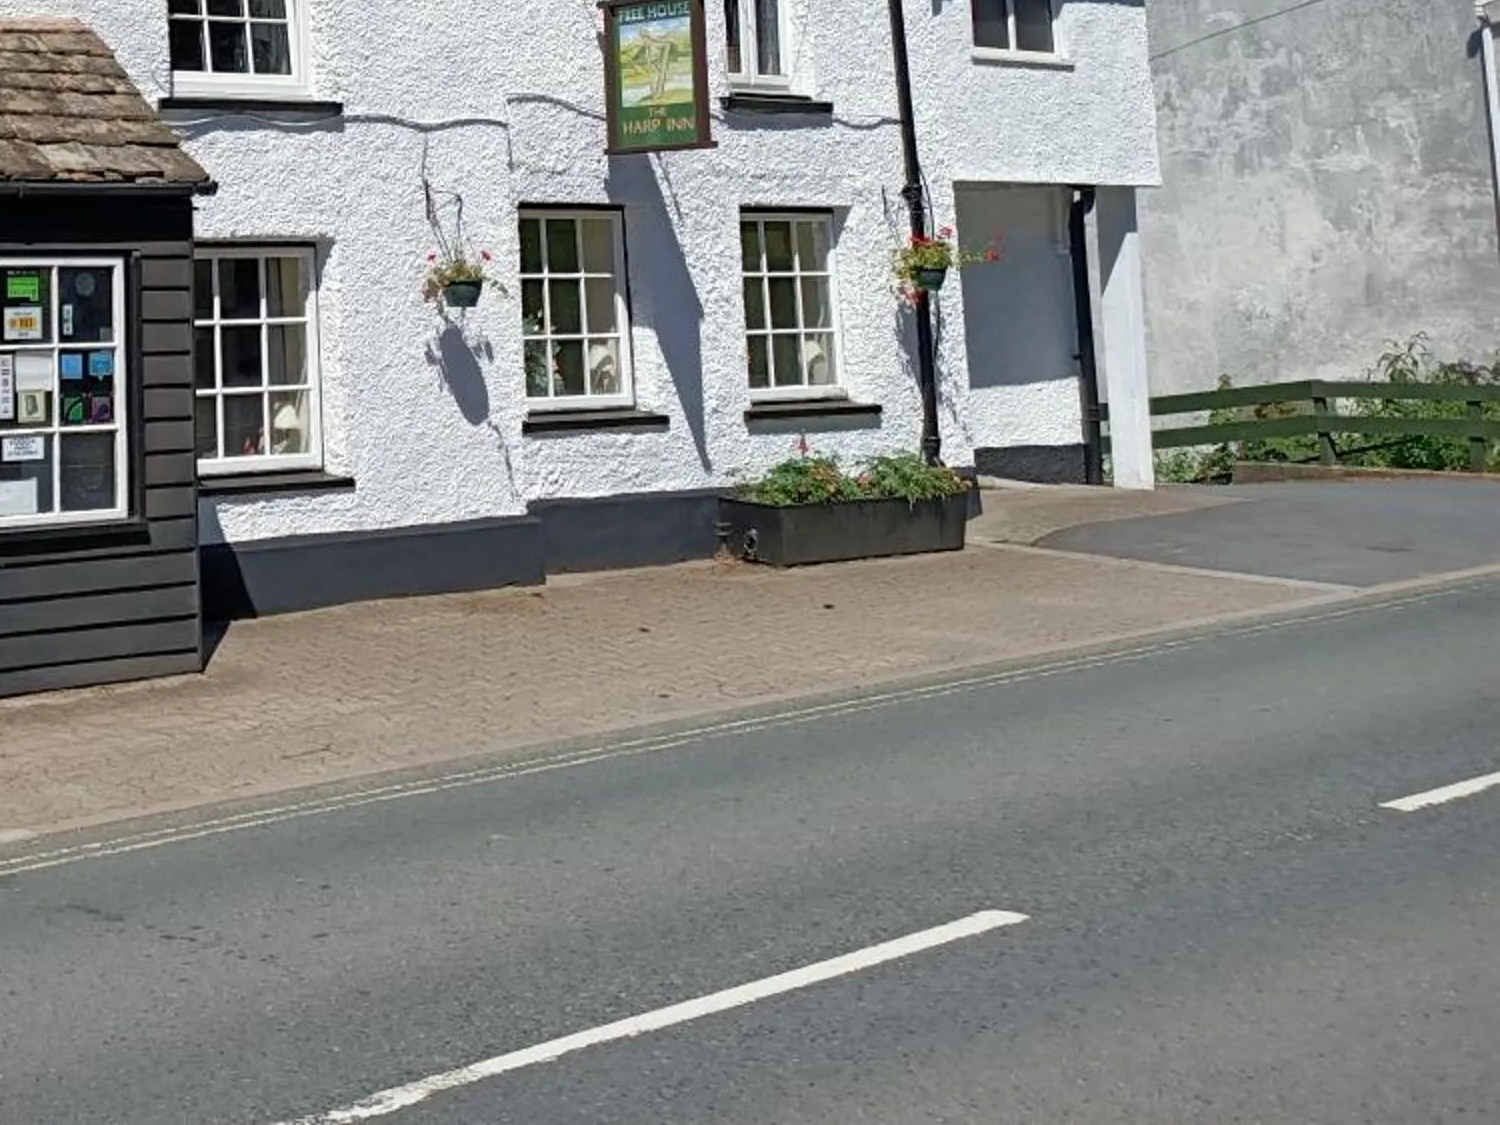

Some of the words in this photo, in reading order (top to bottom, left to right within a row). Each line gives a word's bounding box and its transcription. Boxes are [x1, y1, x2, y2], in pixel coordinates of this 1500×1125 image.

[619, 6, 645, 24] FREE
[647, 1, 691, 19] HOUSE
[623, 118, 661, 135] HARP
[666, 116, 695, 132] INN
